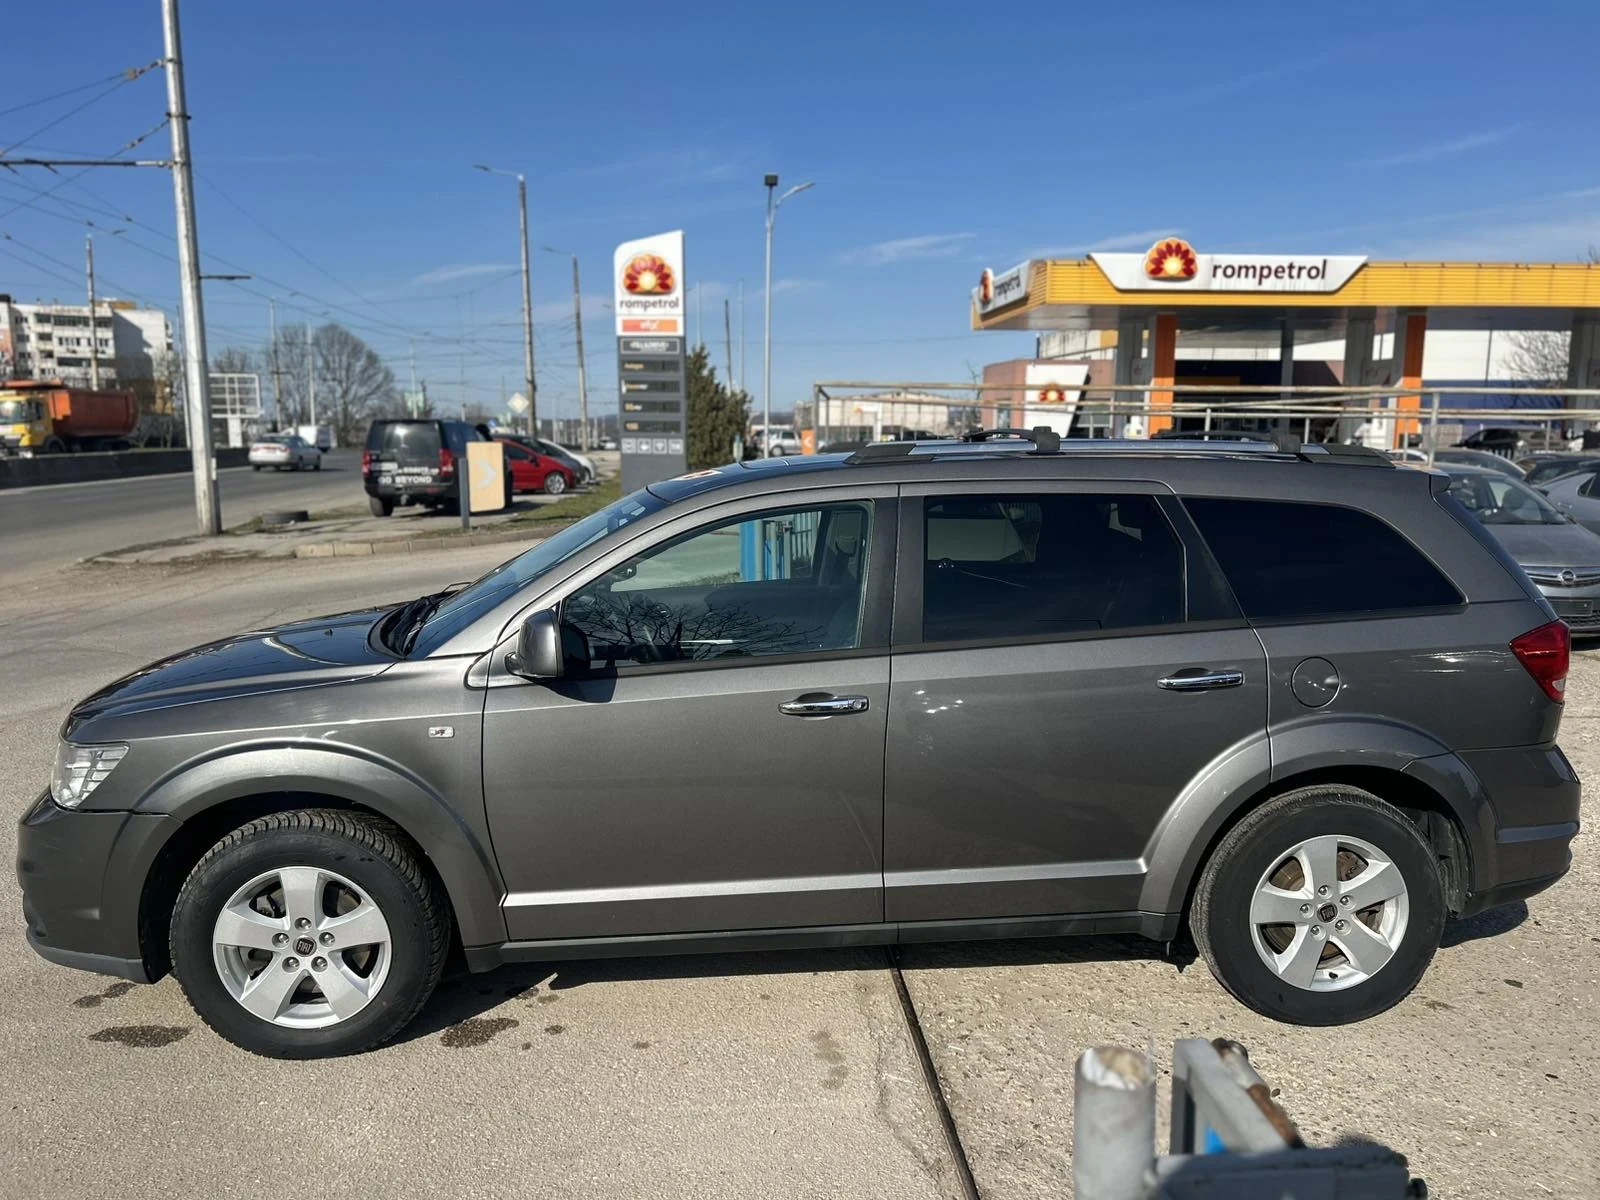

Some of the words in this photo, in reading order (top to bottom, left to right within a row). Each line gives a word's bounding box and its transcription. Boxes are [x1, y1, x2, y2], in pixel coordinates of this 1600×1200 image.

[1212, 258, 1327, 286] rompetrol
[620, 297, 679, 312] rompetrol
[297, 940, 313, 954] FIAT
